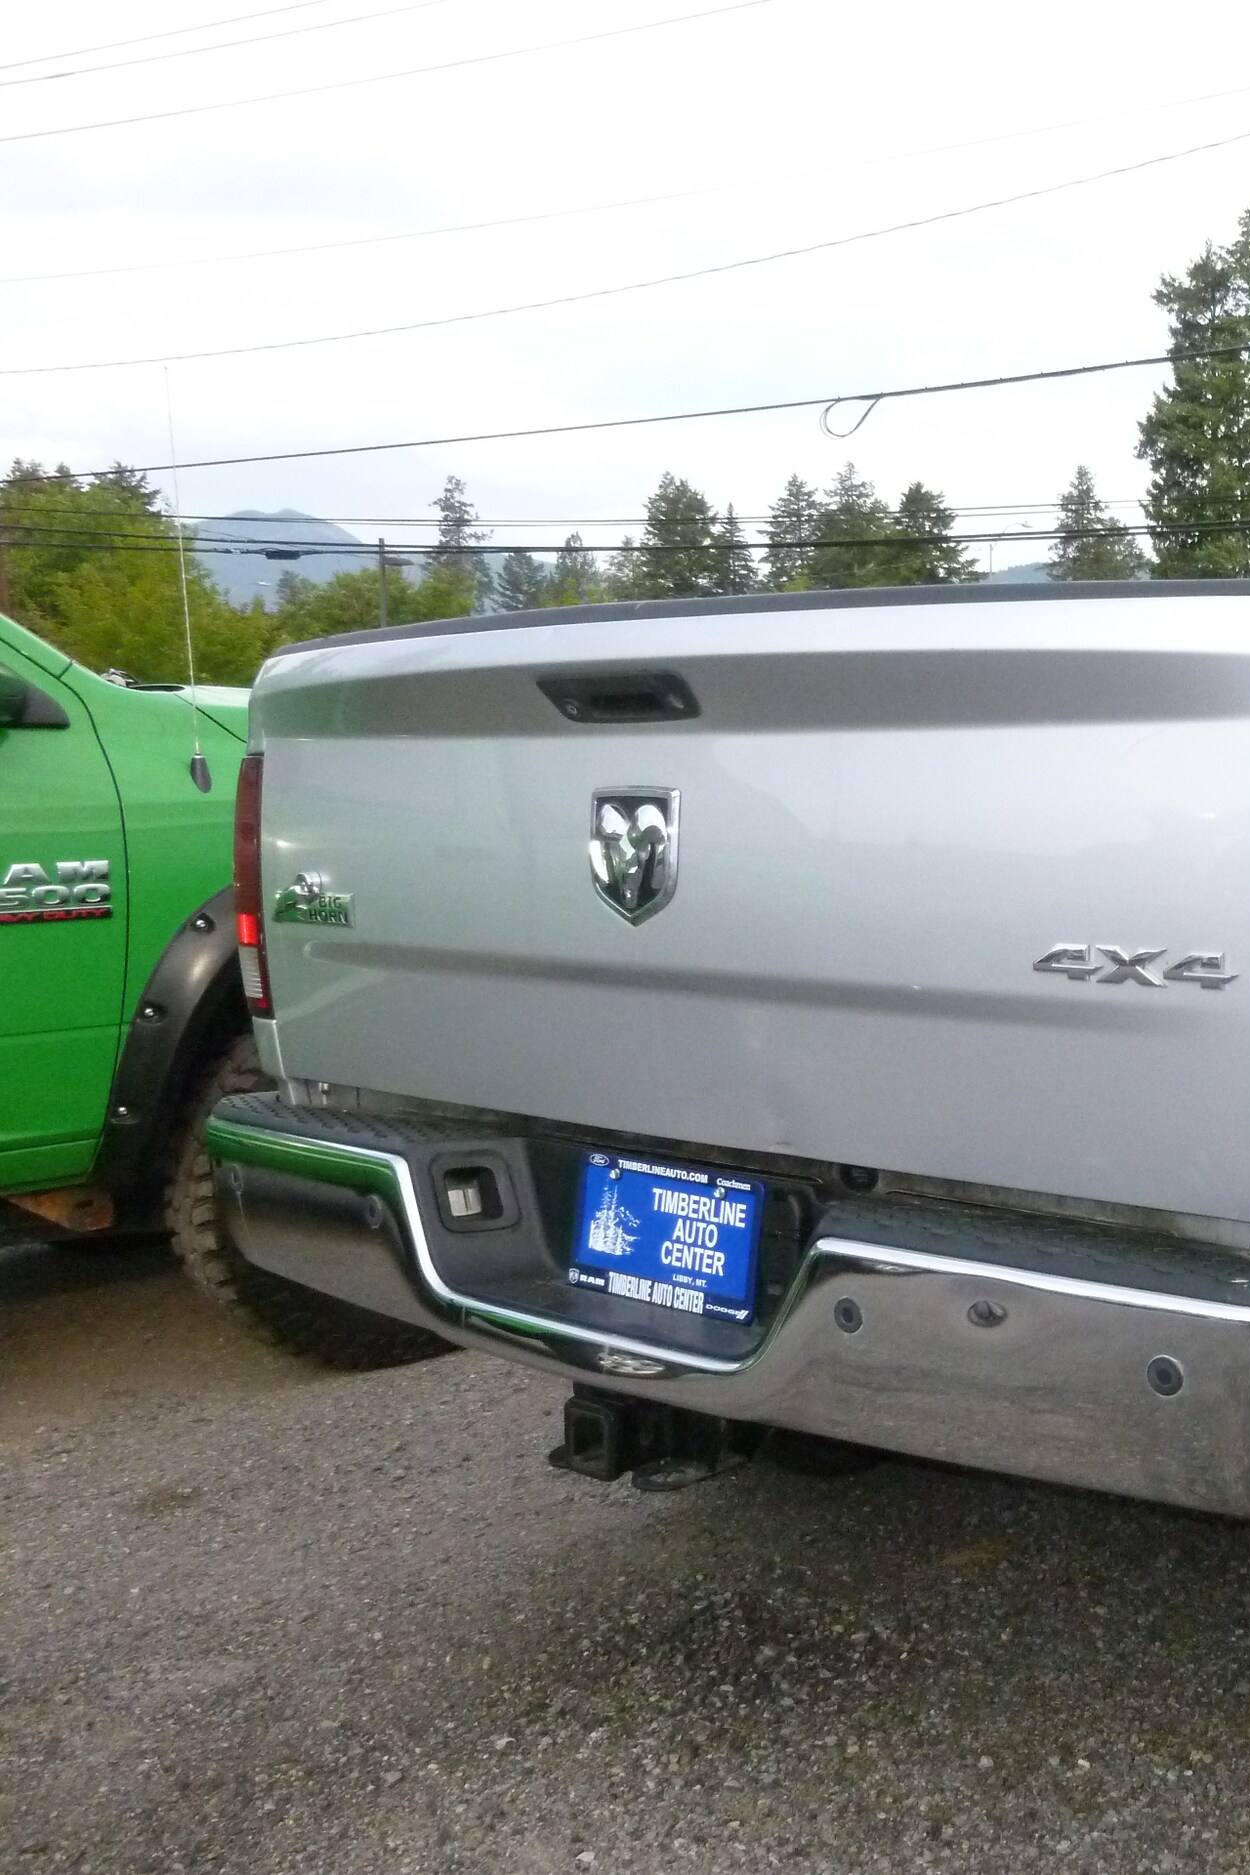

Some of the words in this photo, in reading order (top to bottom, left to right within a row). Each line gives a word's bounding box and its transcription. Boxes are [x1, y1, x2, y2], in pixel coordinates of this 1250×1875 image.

[0, 860, 109, 885] AM
[0, 884, 111, 908] 500
[318, 895, 342, 909] BIG
[308, 909, 349, 925] HORN
[1033, 943, 1239, 990] 4X4
[618, 1159, 708, 1184] TIMBERLINEAUTO.COM
[716, 1177, 751, 1191] Coachmen
[652, 1187, 747, 1228] TIMBERLINE
[672, 1218, 718, 1248] AUTO
[661, 1240, 725, 1276] CENTER
[580, 1274, 605, 1286] RAM
[672, 1273, 695, 1286] LIBBY,
[695, 1278, 708, 1288] MT.
[608, 1271, 653, 1301] TIMBERLINE
[651, 1281, 673, 1307] AUTO
[673, 1286, 705, 1315] CENTER
[705, 1303, 741, 1316] DODGE
